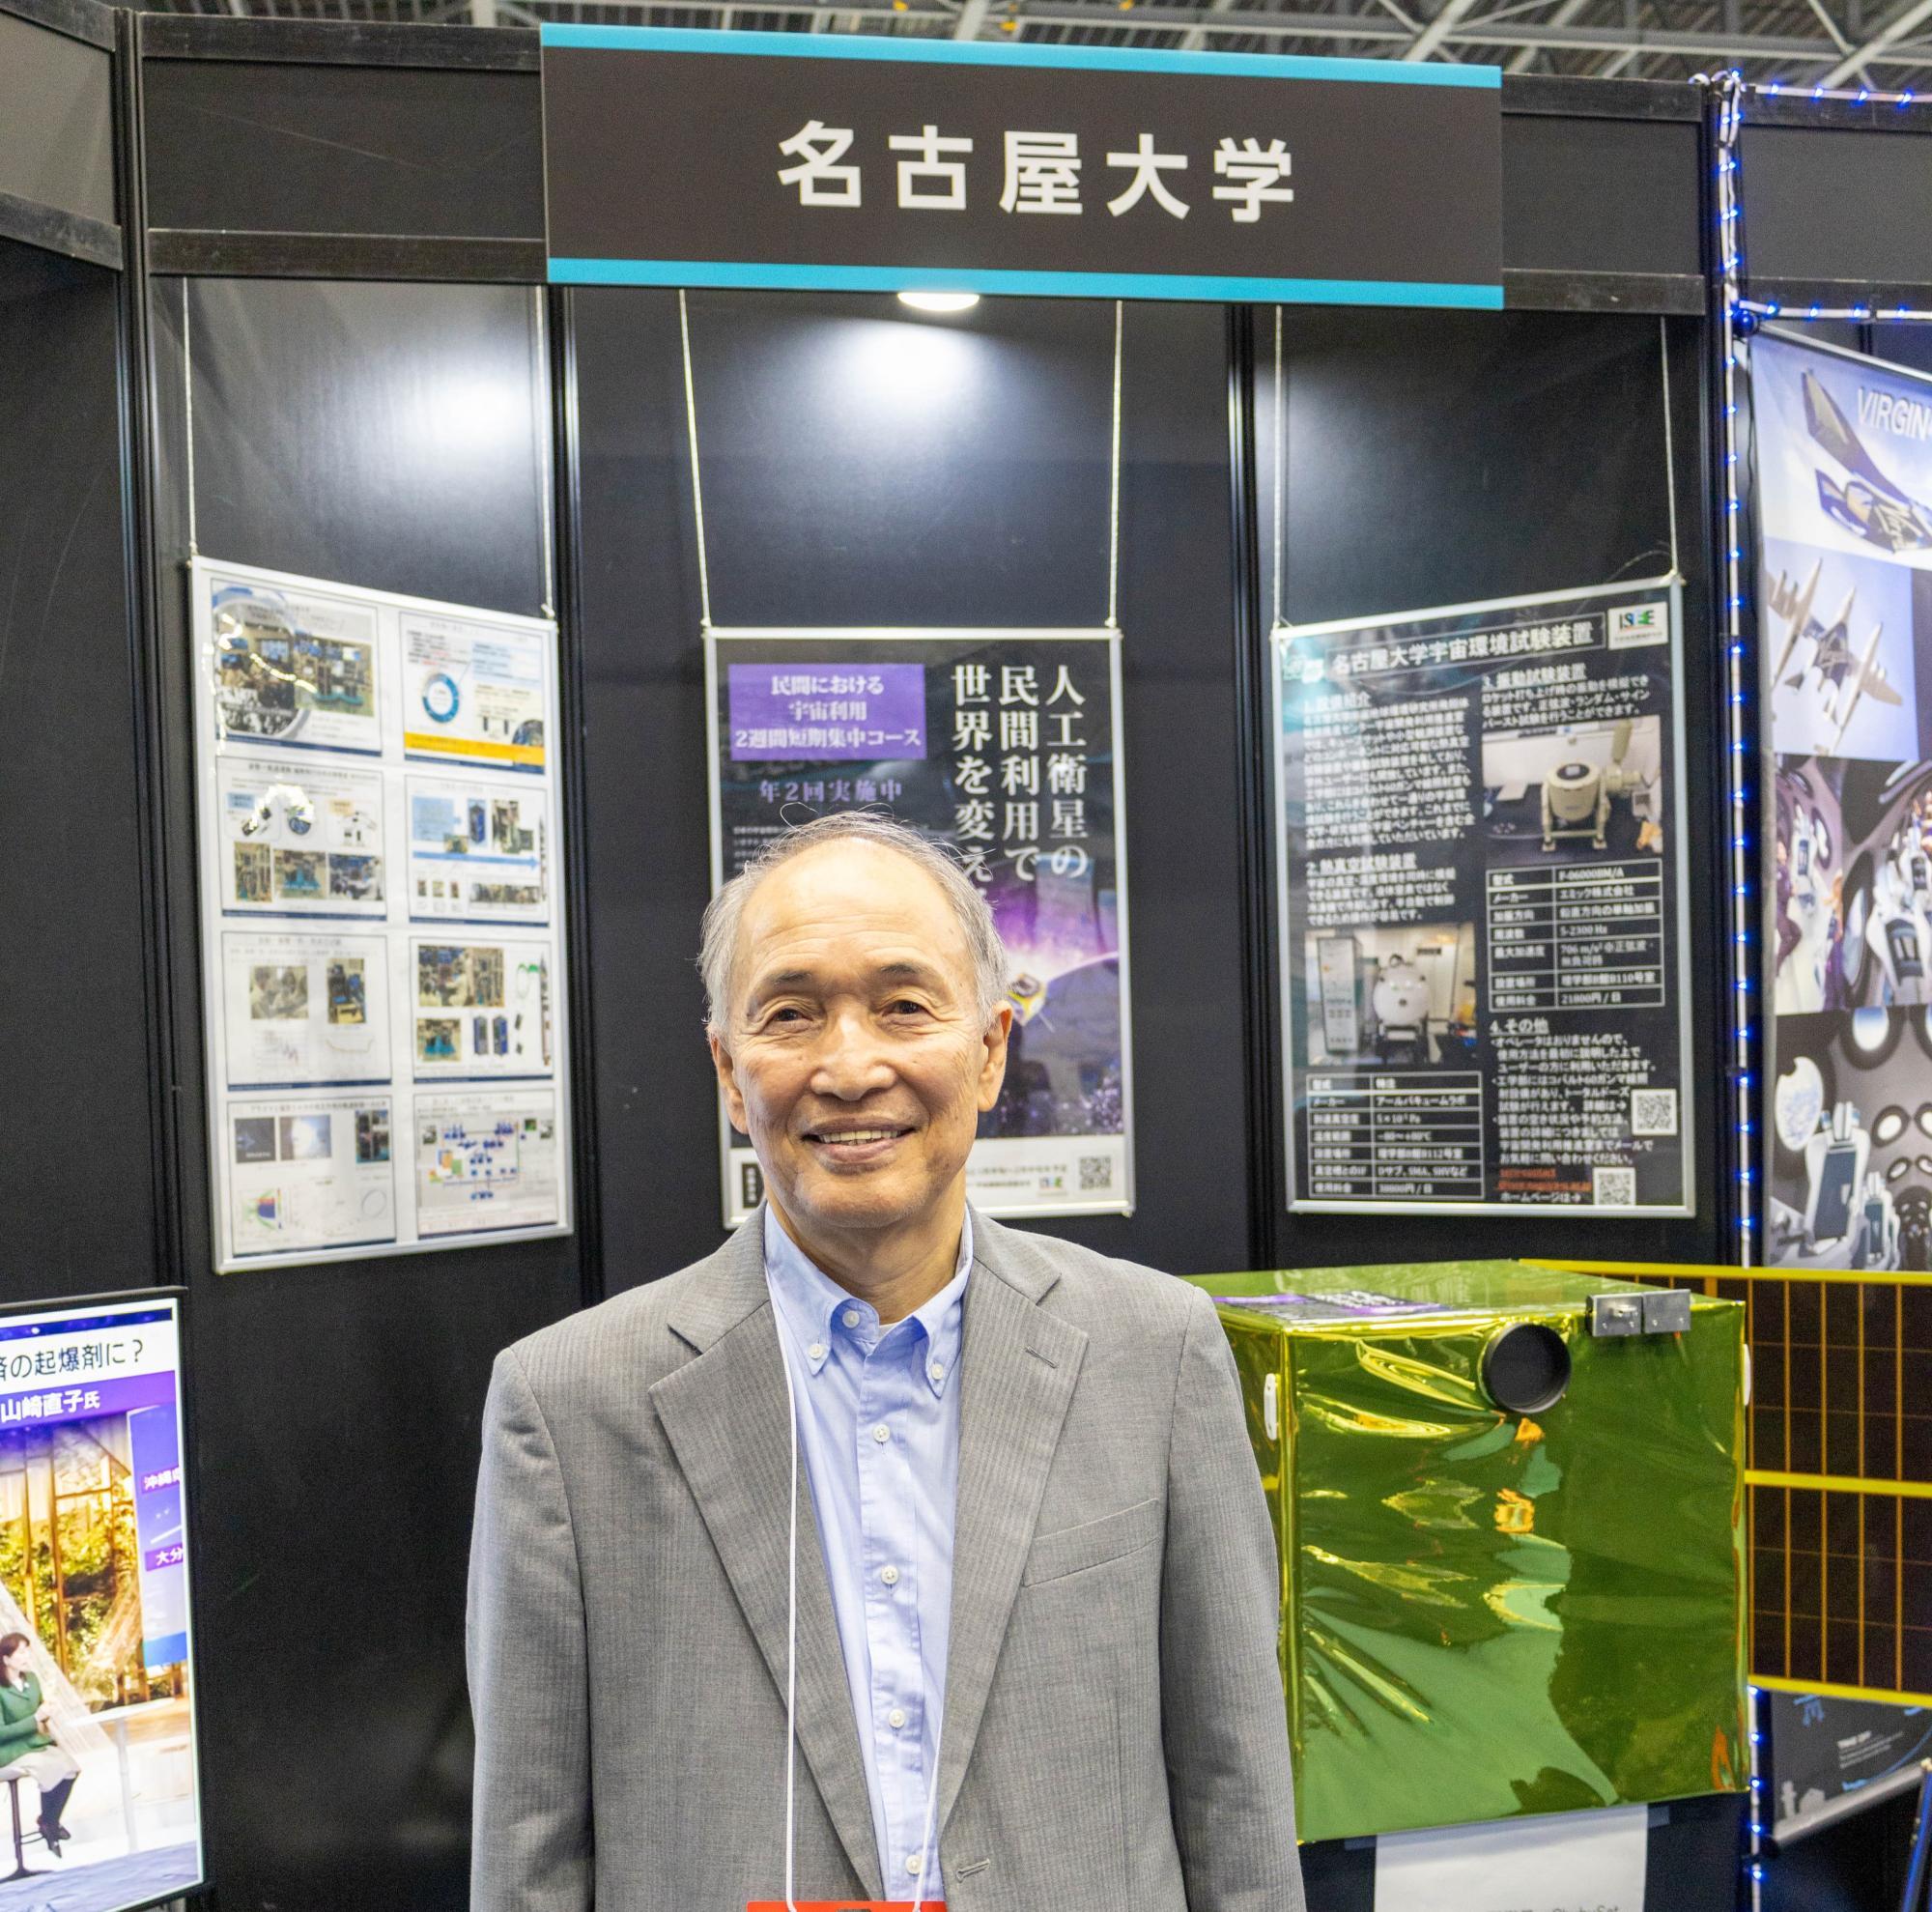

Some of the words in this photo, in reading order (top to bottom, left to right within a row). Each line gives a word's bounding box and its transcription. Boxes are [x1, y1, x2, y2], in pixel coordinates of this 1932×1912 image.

[778, 120, 1293, 223] 名古屋大学
[1858, 386, 1932, 442] VIRGIN
[1332, 621, 1594, 675] 名古屋大学宇宙環境試験装置
[771, 674, 885, 696] 民間における
[788, 700, 867, 722] 宇宙利用
[735, 728, 922, 750] 2週間短期集中コース
[759, 779, 902, 804] 年2回実施中
[951, 665, 995, 897] 世界を変え
[998, 665, 1039, 881] 民間利用で
[1046, 665, 1088, 879] 人工衛星の
[156, 1547, 183, 1566] 大分
